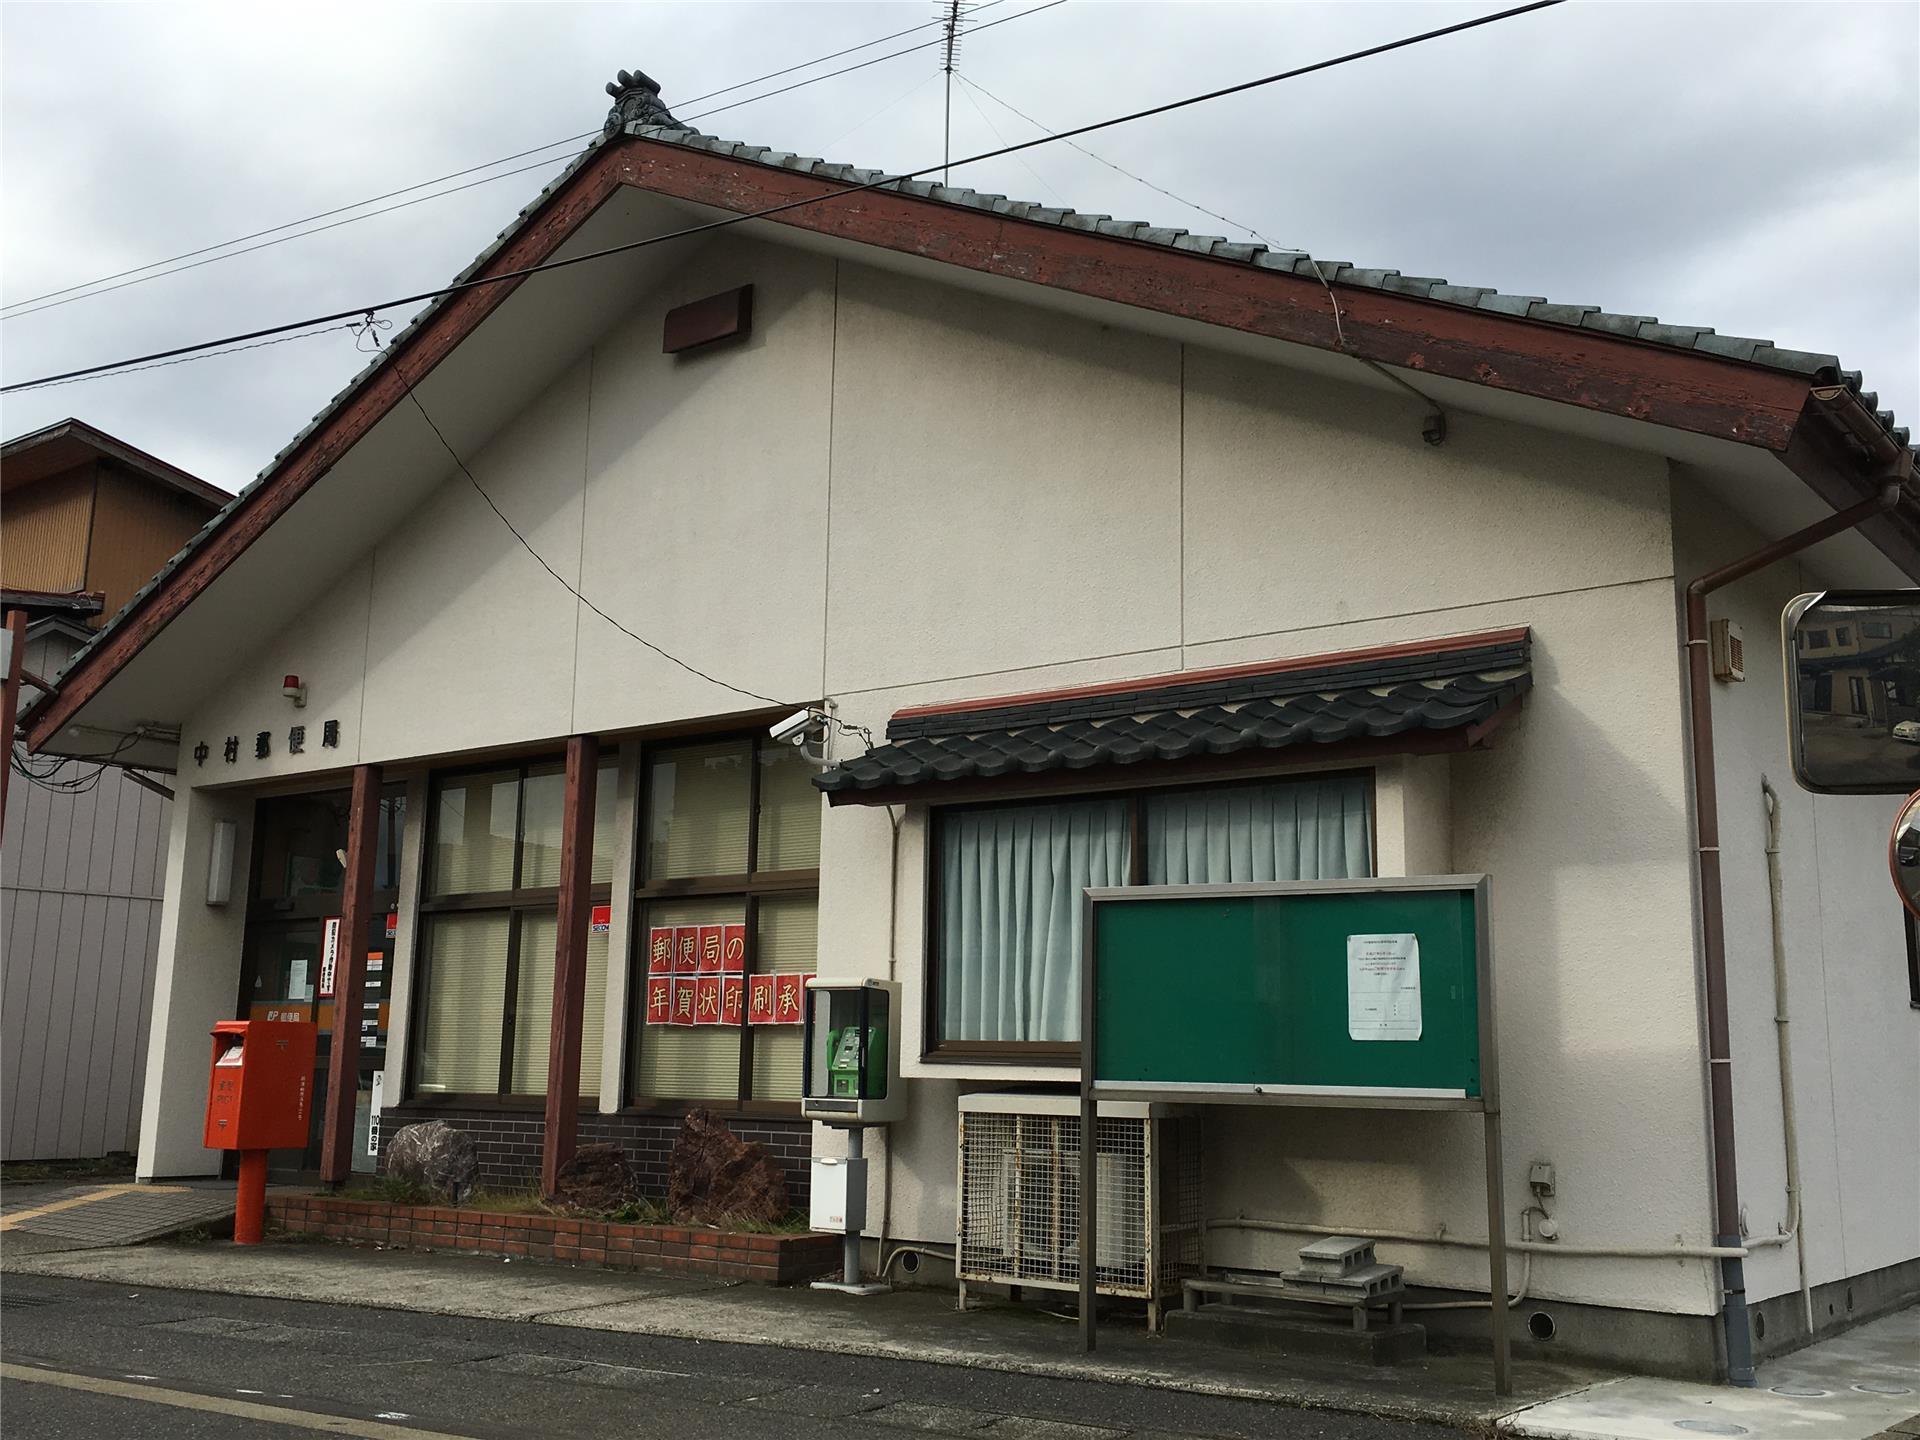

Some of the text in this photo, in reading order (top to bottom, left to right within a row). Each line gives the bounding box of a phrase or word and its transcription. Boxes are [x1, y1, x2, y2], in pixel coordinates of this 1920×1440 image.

[194, 719, 340, 767] 中村郵便局
[652, 934, 745, 967] 郵便局の
